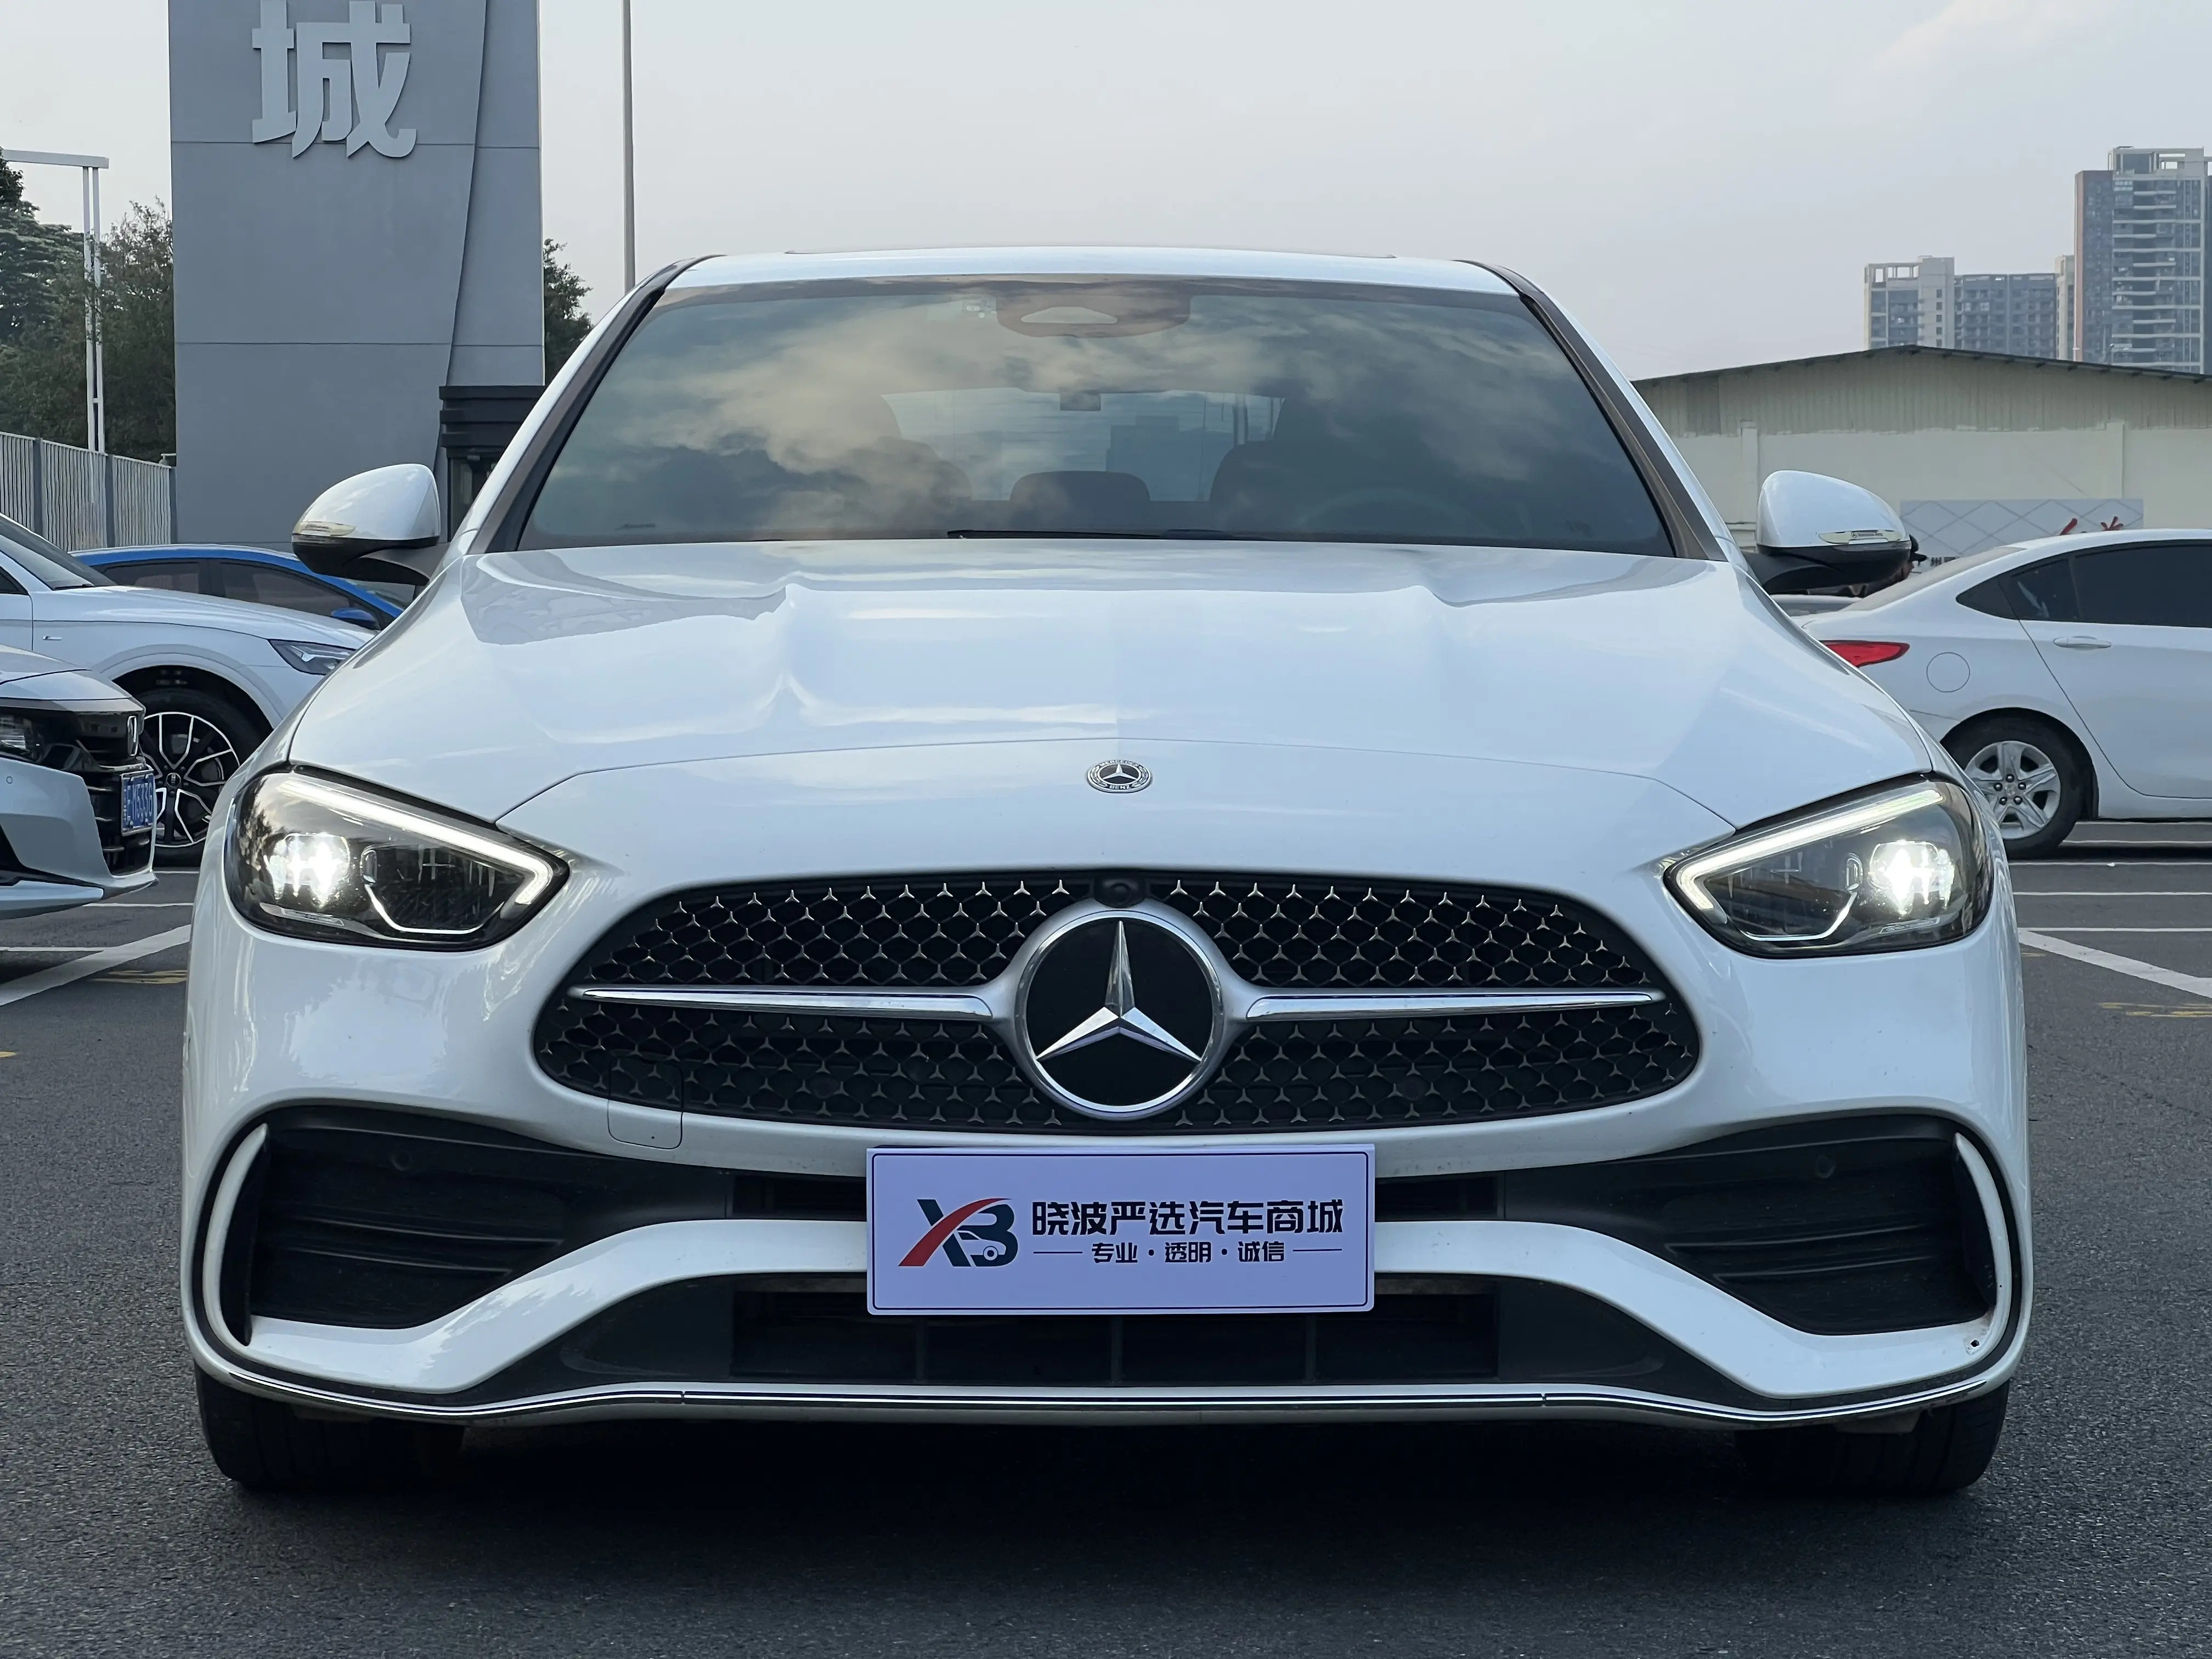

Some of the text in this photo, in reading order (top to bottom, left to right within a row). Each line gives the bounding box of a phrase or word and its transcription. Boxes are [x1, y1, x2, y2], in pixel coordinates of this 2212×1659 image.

[252, 0, 417, 159] 城
[1032, 1199, 1342, 1235] 晓波严选汽车商城
